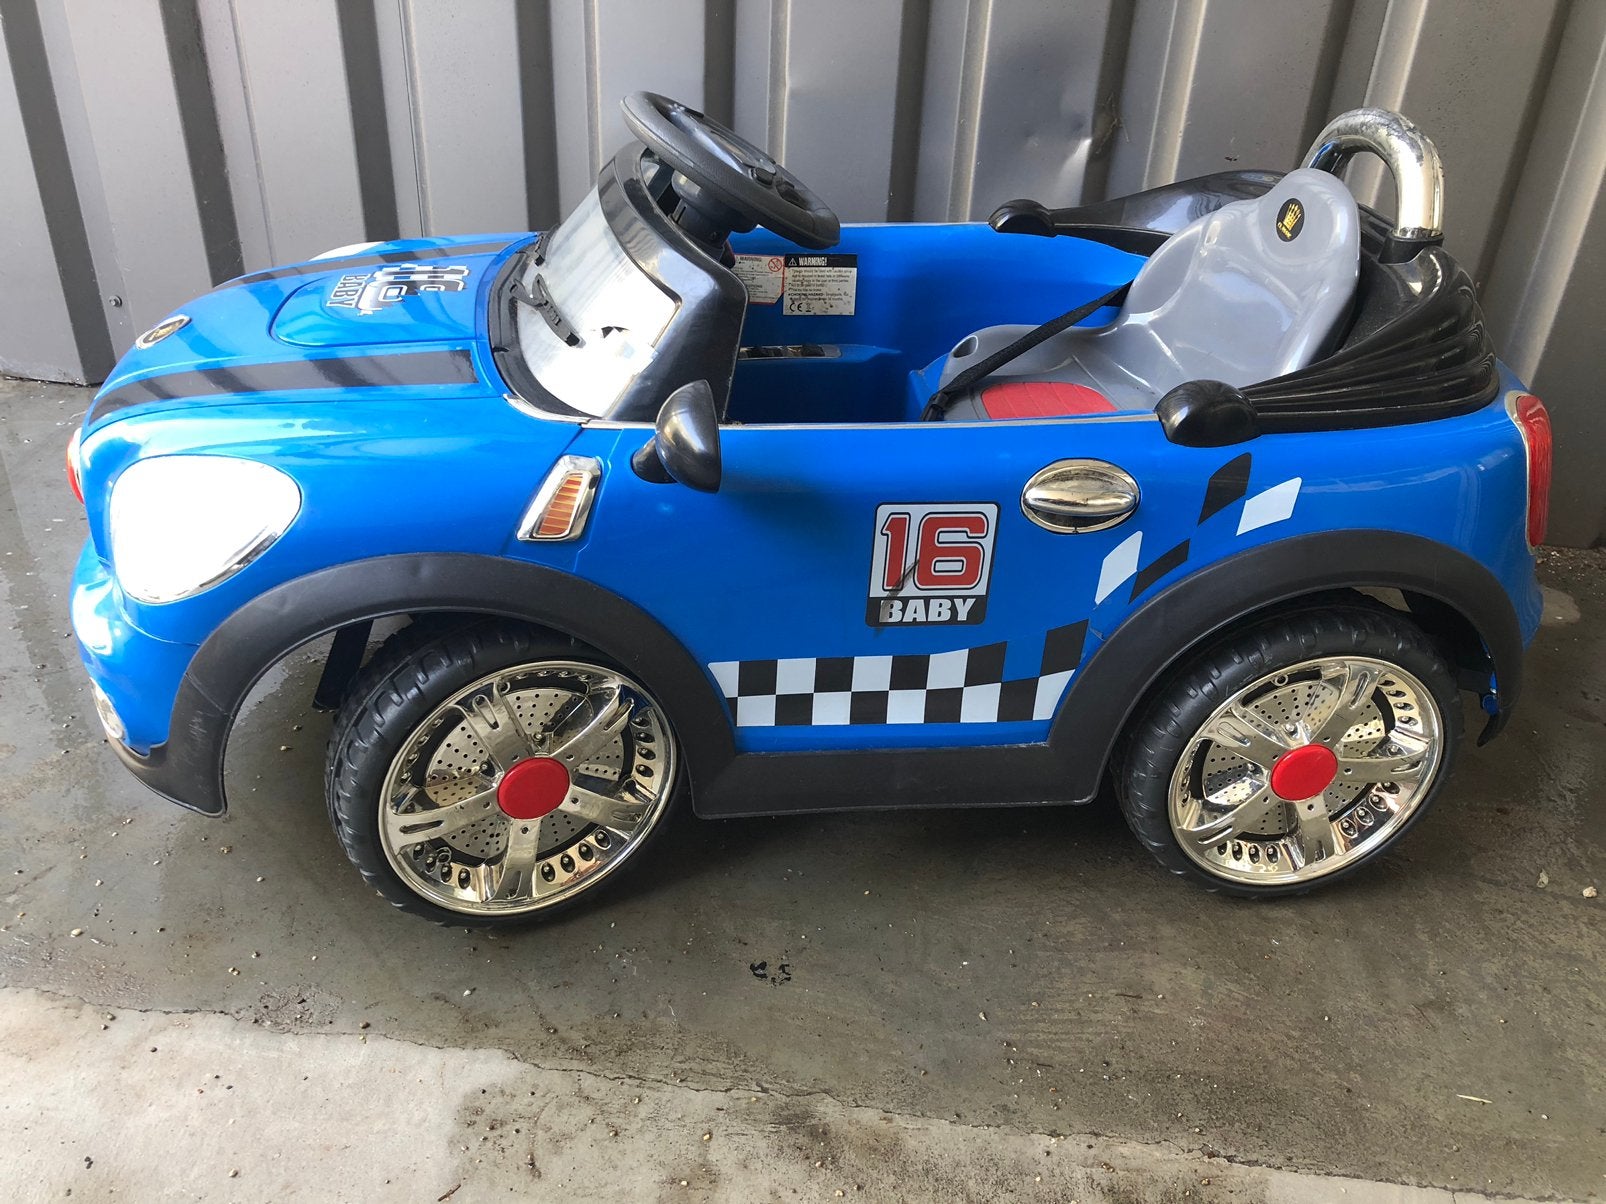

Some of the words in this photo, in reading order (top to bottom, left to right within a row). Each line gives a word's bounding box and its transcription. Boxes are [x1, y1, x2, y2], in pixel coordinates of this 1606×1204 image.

[798, 257, 827, 266] WARNING!
[880, 511, 988, 591] 16
[879, 598, 976, 623] BABY
